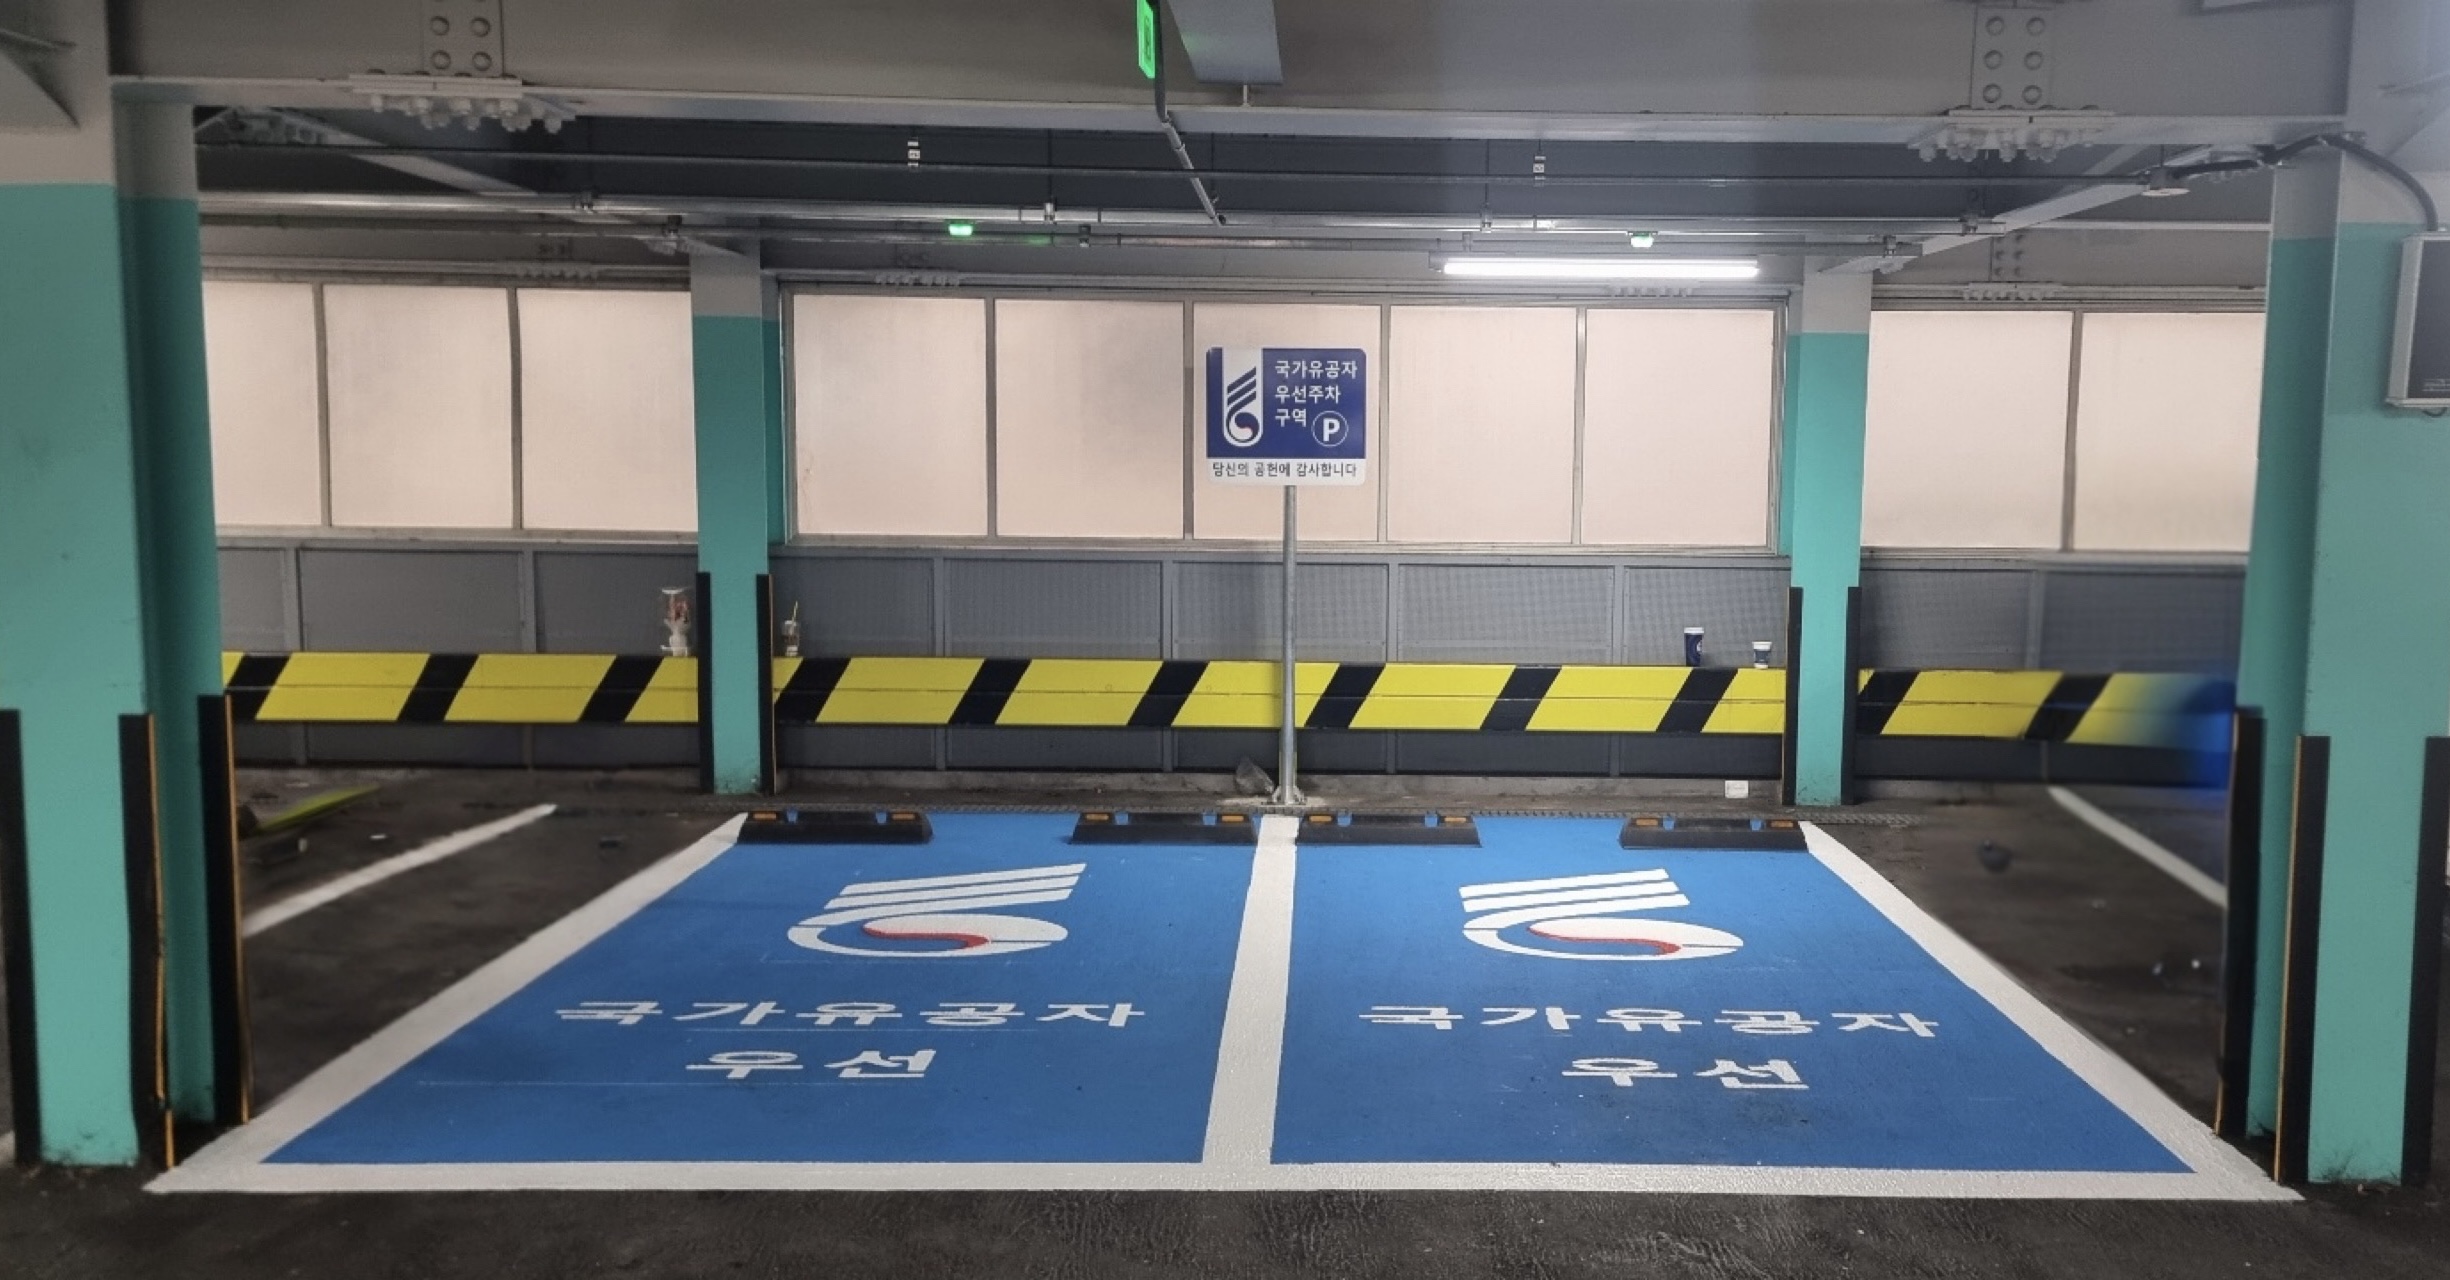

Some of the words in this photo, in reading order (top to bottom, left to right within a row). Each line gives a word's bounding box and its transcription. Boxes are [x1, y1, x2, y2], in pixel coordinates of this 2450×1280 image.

[1274, 360, 1357, 379] 국가유공자
[1274, 384, 1341, 404] 우선주차
[1274, 408, 1307, 428] 구역
[1322, 417, 1340, 442] P
[1212, 462, 1250, 477] 당신의
[1255, 462, 1291, 477] 공헌에
[1296, 462, 1357, 477] 감사합니다
[555, 1001, 1145, 1027] 국가유공자
[1358, 1005, 1939, 1037] 국가유공자
[685, 1049, 936, 1079] 우선
[1562, 1057, 1809, 1089] 우선
